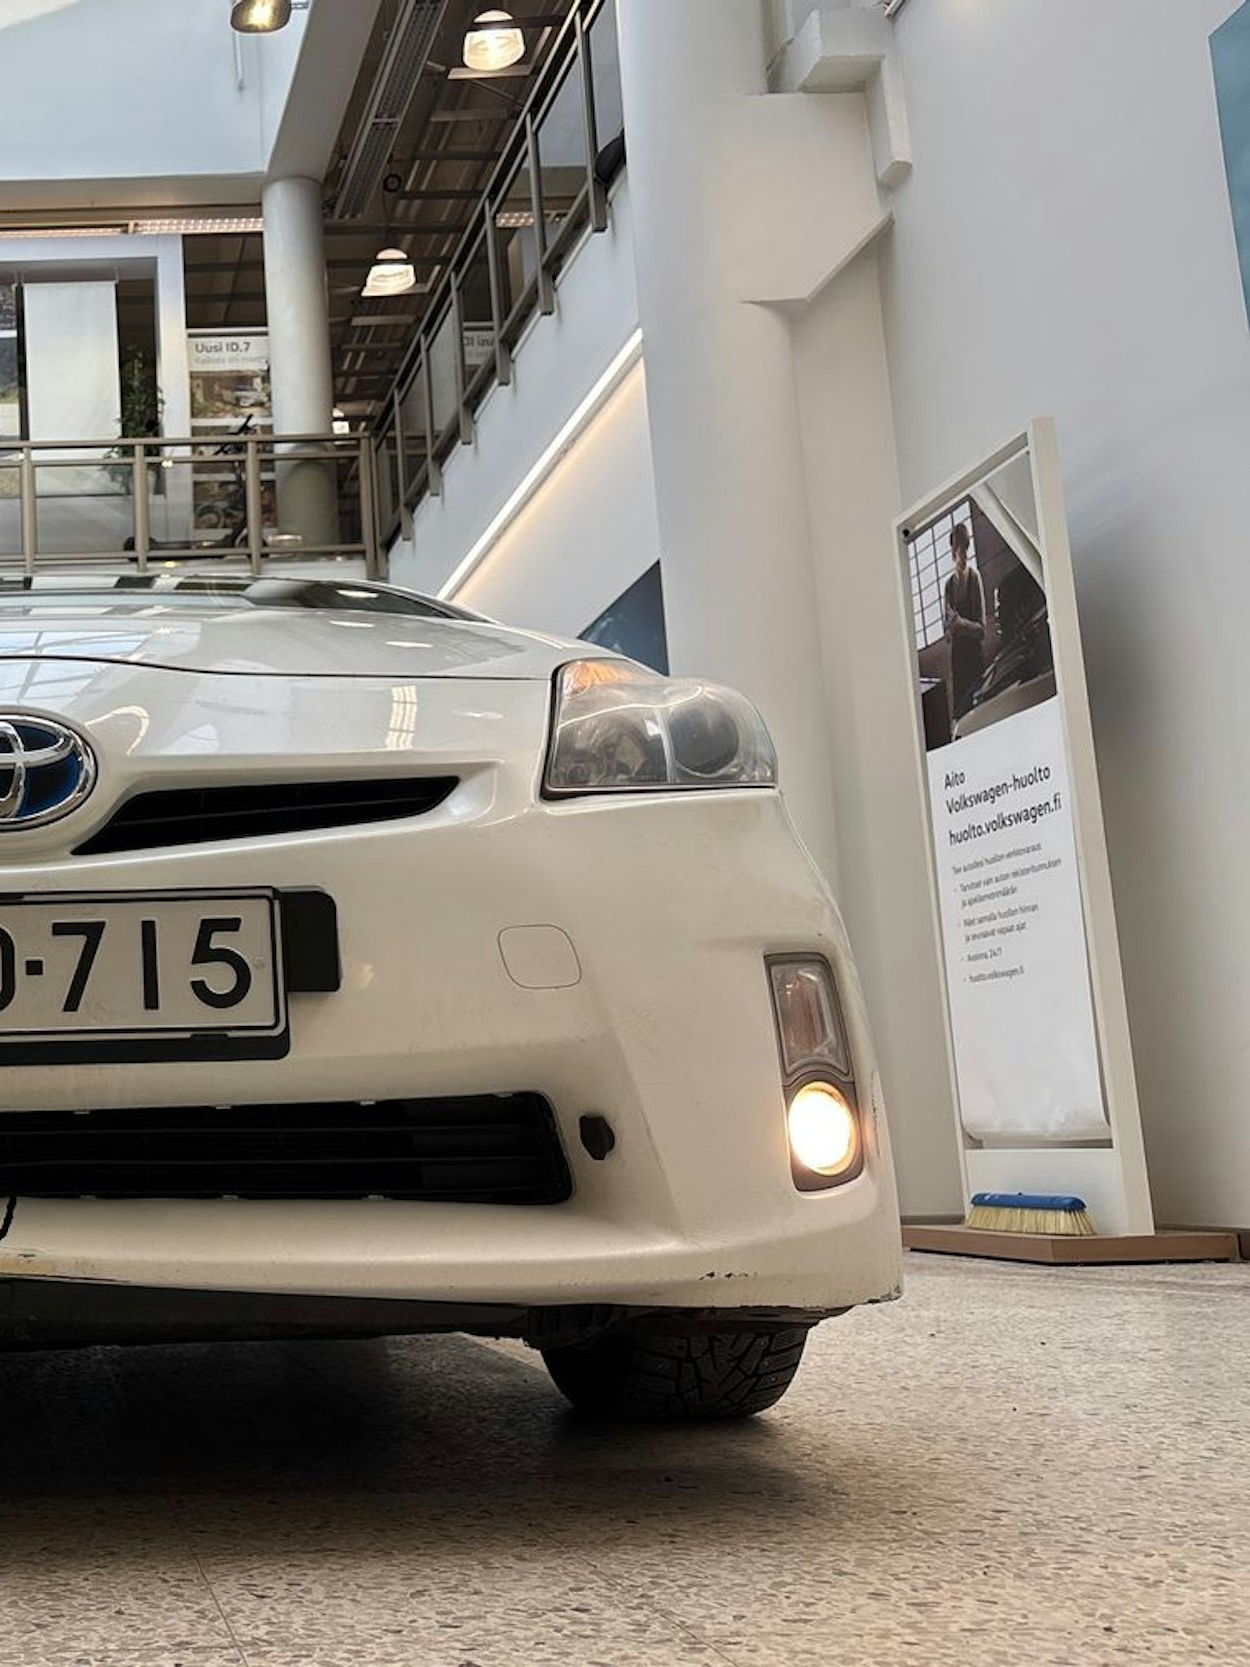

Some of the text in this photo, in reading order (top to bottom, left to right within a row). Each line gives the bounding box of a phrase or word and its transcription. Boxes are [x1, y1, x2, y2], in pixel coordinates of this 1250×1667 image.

[195, 342, 250, 353] Uusi ID.7
[944, 771, 966, 790] Aito
[946, 766, 1051, 814] Volkswagen-huolto
[949, 792, 1063, 845] huolto.volkswagen.fi
